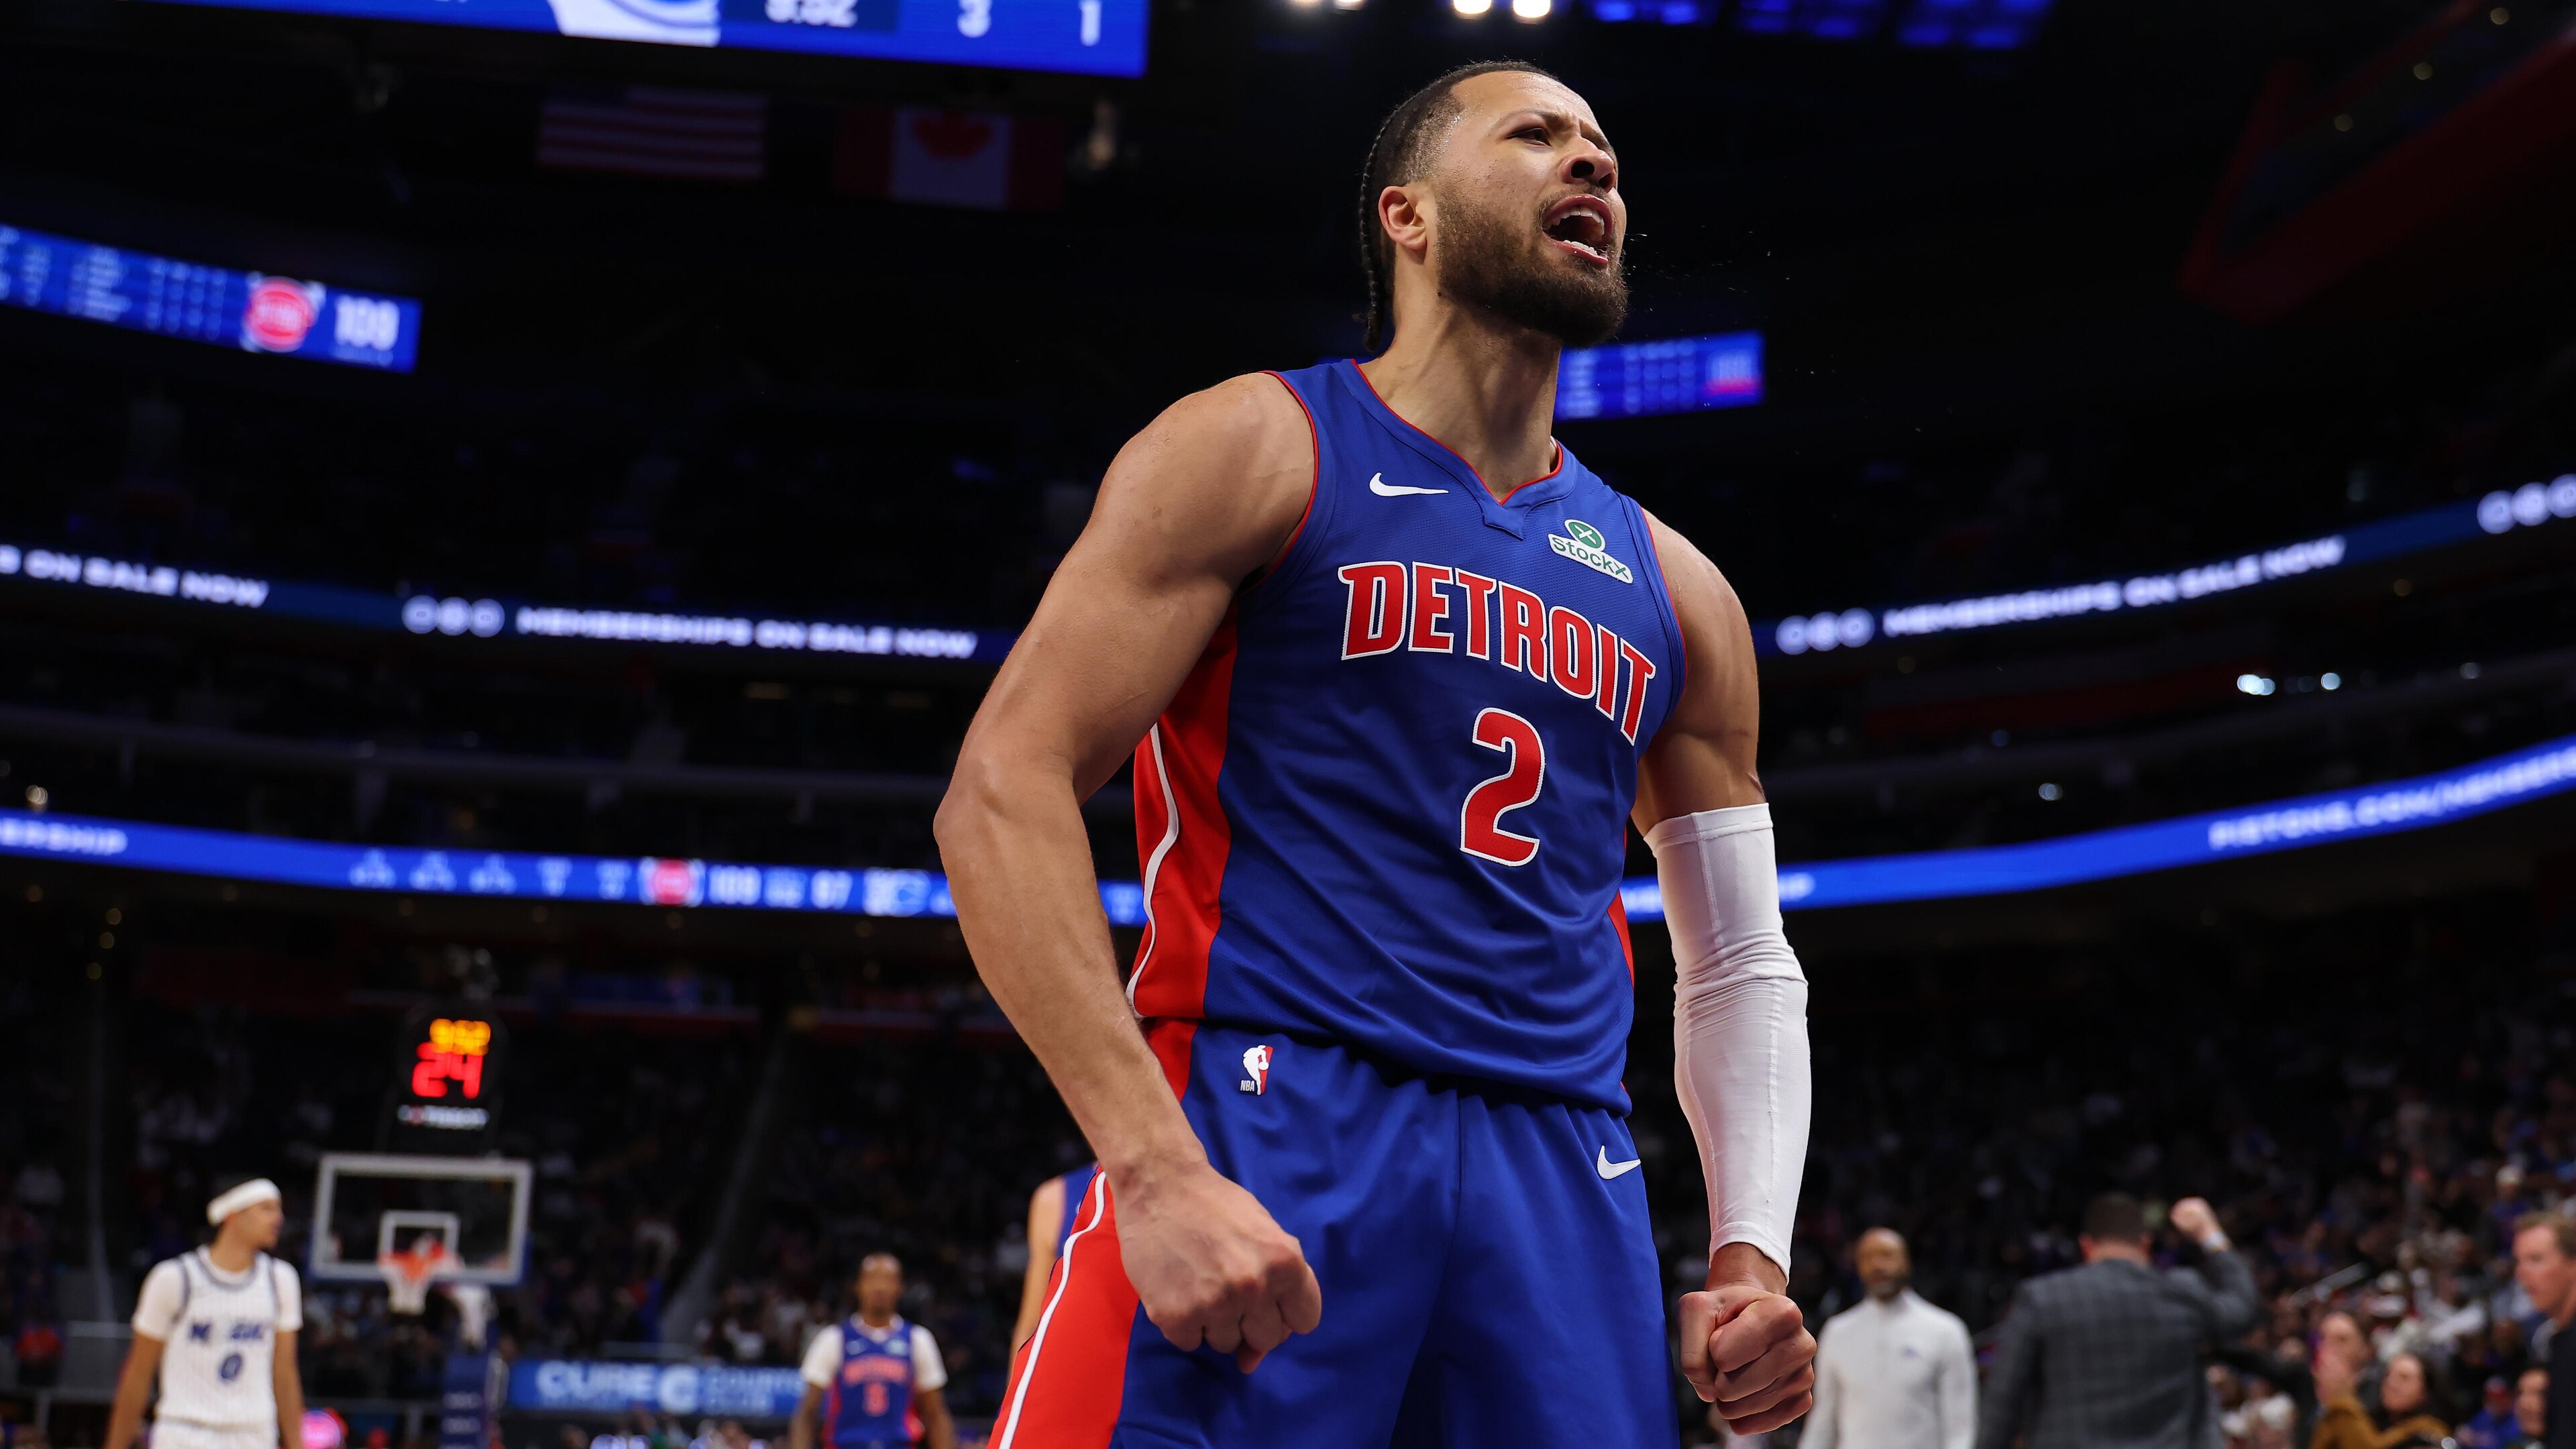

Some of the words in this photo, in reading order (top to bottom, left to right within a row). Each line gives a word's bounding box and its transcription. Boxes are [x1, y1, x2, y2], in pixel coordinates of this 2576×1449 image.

[23, 549, 81, 582] ON
[83, 557, 177, 596] SALE
[179, 571, 268, 607] NOW
[1883, 581, 2122, 637] MEMBERSHIPS
[2122, 574, 2178, 607] ON
[2178, 554, 2261, 599] SALE
[2261, 535, 2347, 580] NOW
[516, 606, 753, 646] MEMBERSHIPS
[755, 619, 806, 649] ON
[807, 623, 893, 654] SALE
[894, 628, 977, 659] NOW
[1338, 561, 1656, 746] DETROIT
[1460, 707, 1546, 867] 2
[412, 1041, 483, 1099] 24
[1240, 1079, 1255, 1092] NBA
[219, 1353, 244, 1381] 0
[536, 1361, 659, 1398] CURE
